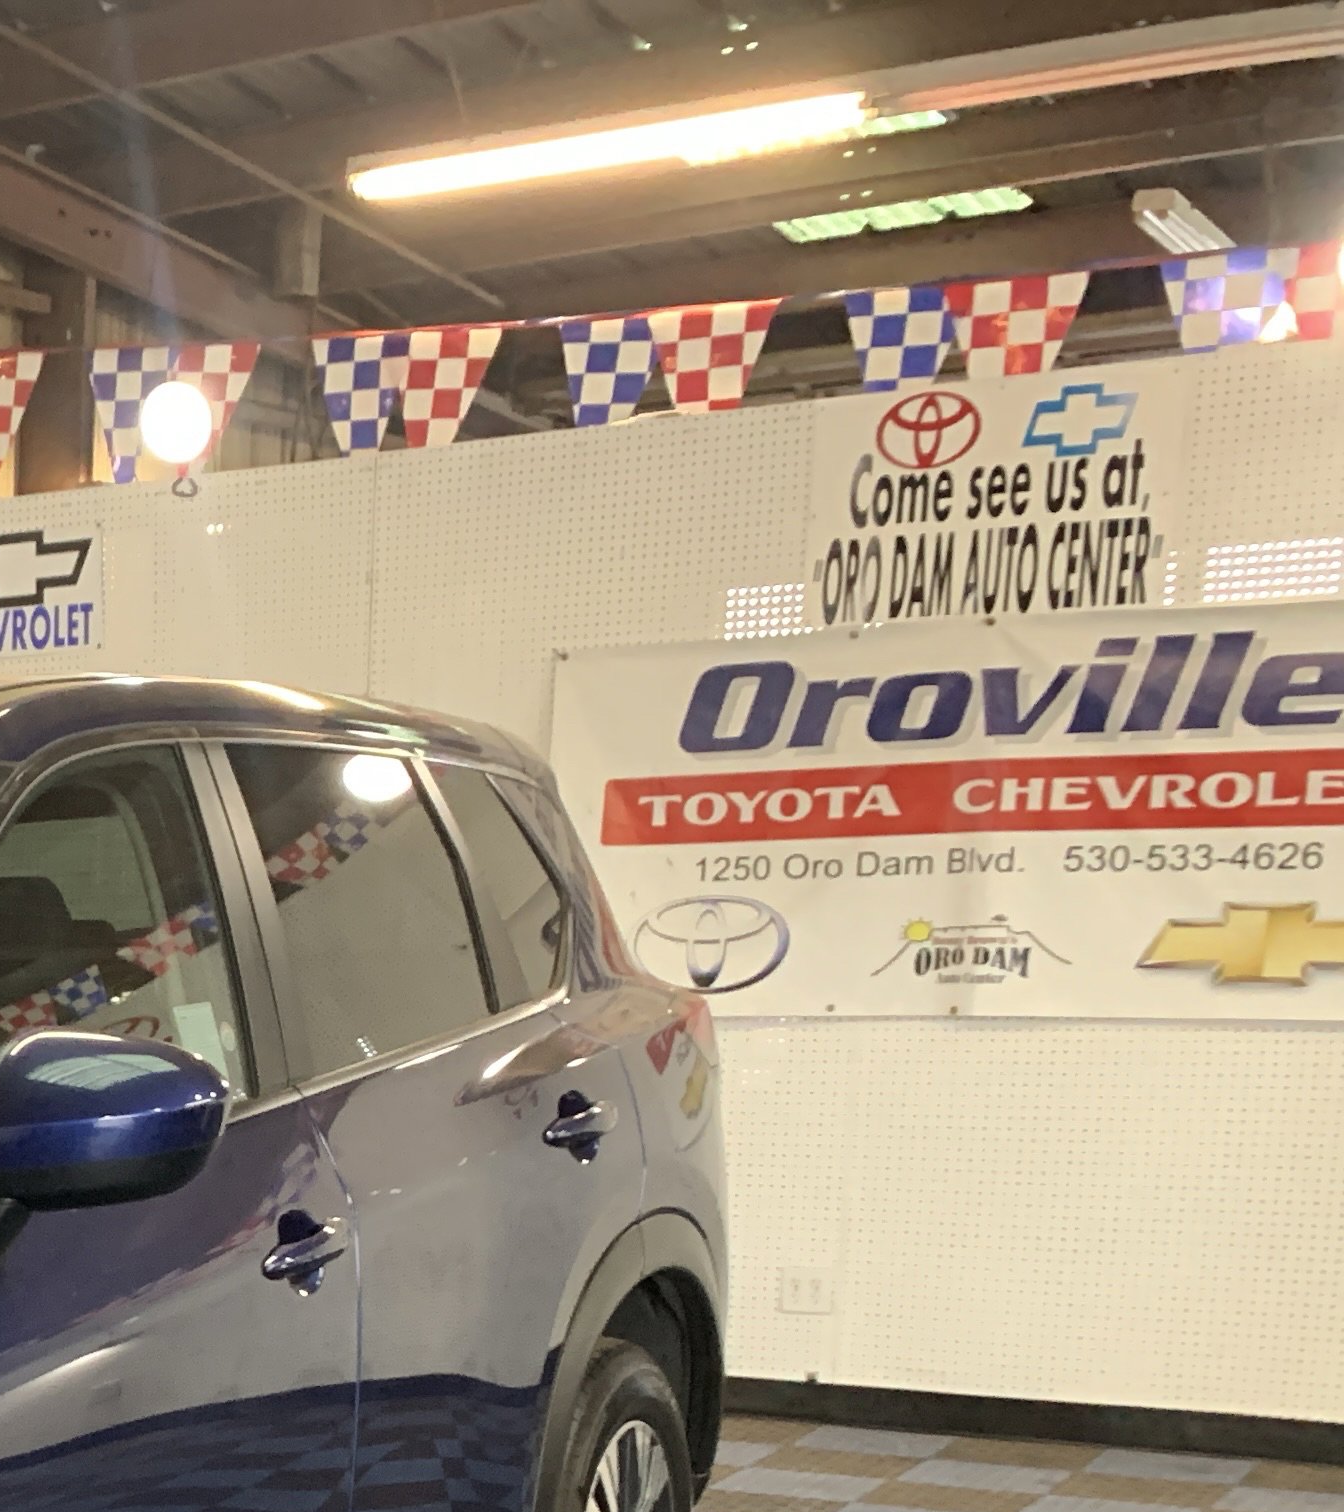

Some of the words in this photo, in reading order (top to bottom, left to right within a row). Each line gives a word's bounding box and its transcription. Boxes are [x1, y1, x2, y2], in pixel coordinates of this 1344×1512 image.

[849, 454, 954, 529] Come
[965, 463, 1031, 520] see
[1045, 457, 1089, 513] us
[1102, 437, 1150, 512] at,
[888, 531, 955, 619] DAM
[961, 522, 1038, 615] AUTO
[679, 631, 1344, 753] Oroville
[637, 783, 902, 828] TOYOTA
[953, 770, 1344, 815] CHEVROLE
[696, 855, 771, 882] 1250
[783, 852, 843, 880] Oro
[856, 850, 934, 877] Dam
[947, 847, 1025, 875] Blvd.
[1063, 841, 1324, 874] 530-533-4626
[914, 947, 965, 976] ORO
[972, 946, 1032, 978] DAM
